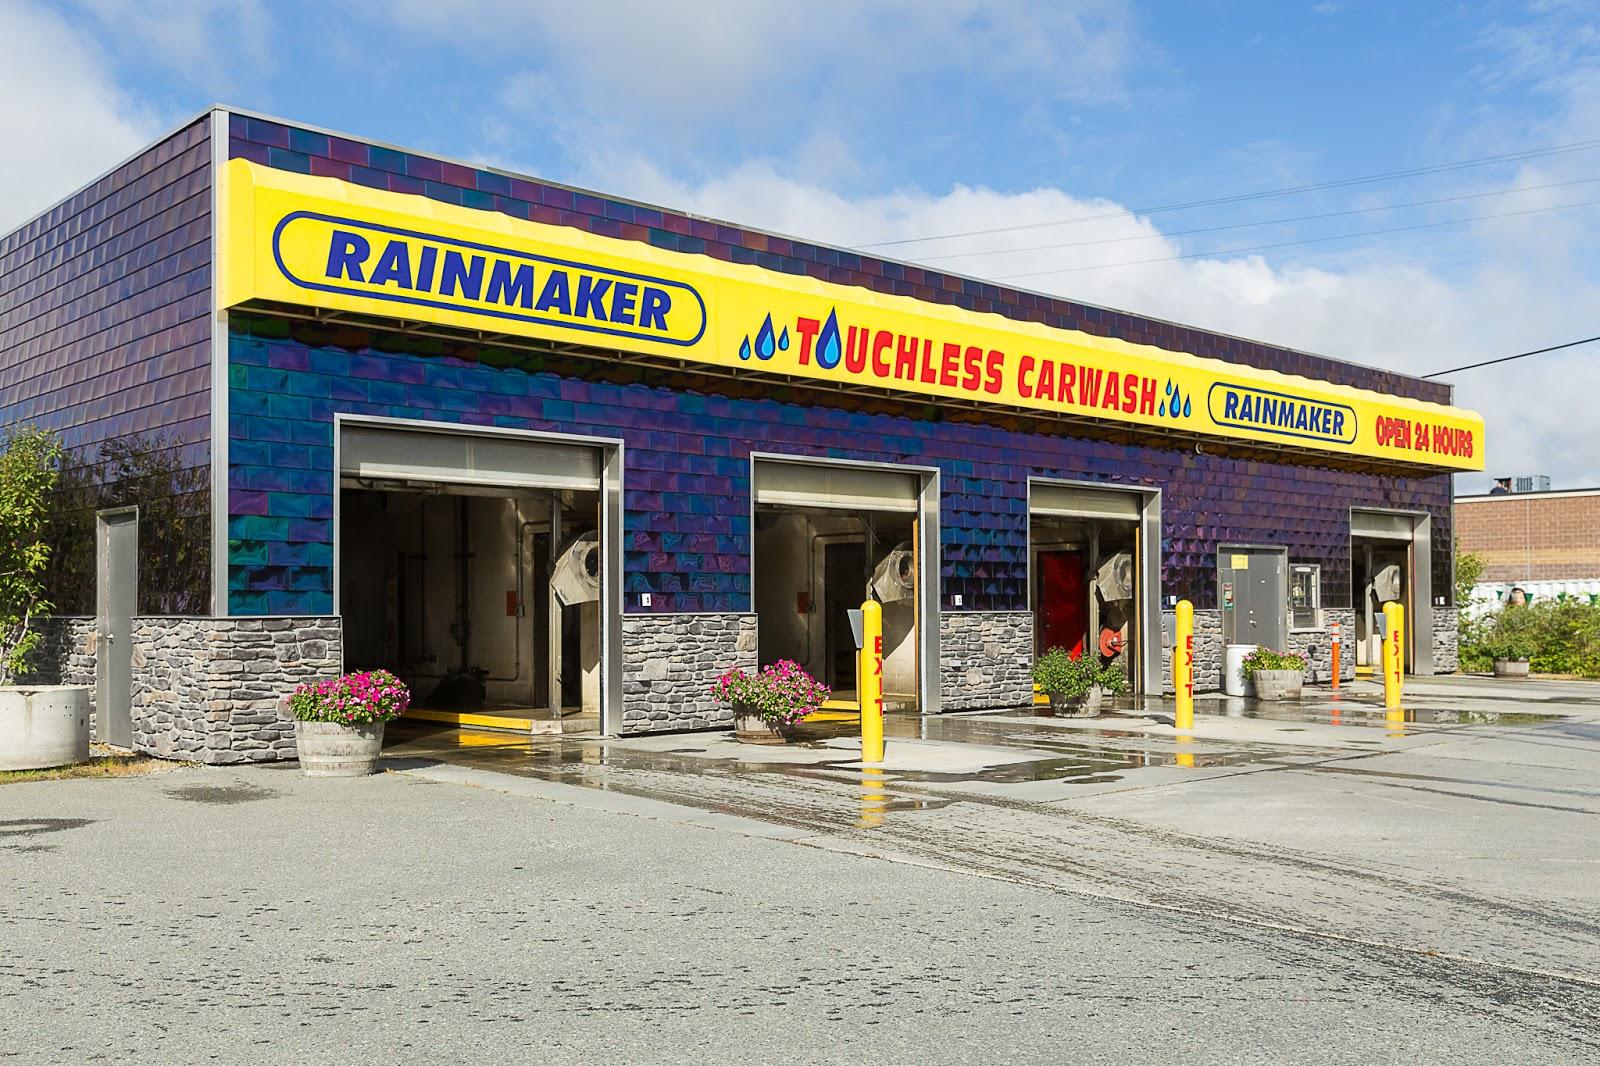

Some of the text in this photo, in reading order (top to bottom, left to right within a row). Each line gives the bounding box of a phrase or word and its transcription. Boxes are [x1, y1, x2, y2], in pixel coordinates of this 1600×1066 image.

[325, 230, 671, 330] RAINMAKER
[796, 306, 1157, 416] TOUCHLESS CARWASH
[1224, 391, 1345, 436] RAINMAKER
[1375, 415, 1473, 458] OPEN 24 HOURS
[873, 635, 884, 717] EXIT
[1184, 635, 1194, 698] EXIT
[1393, 630, 1401, 684] EXIT
